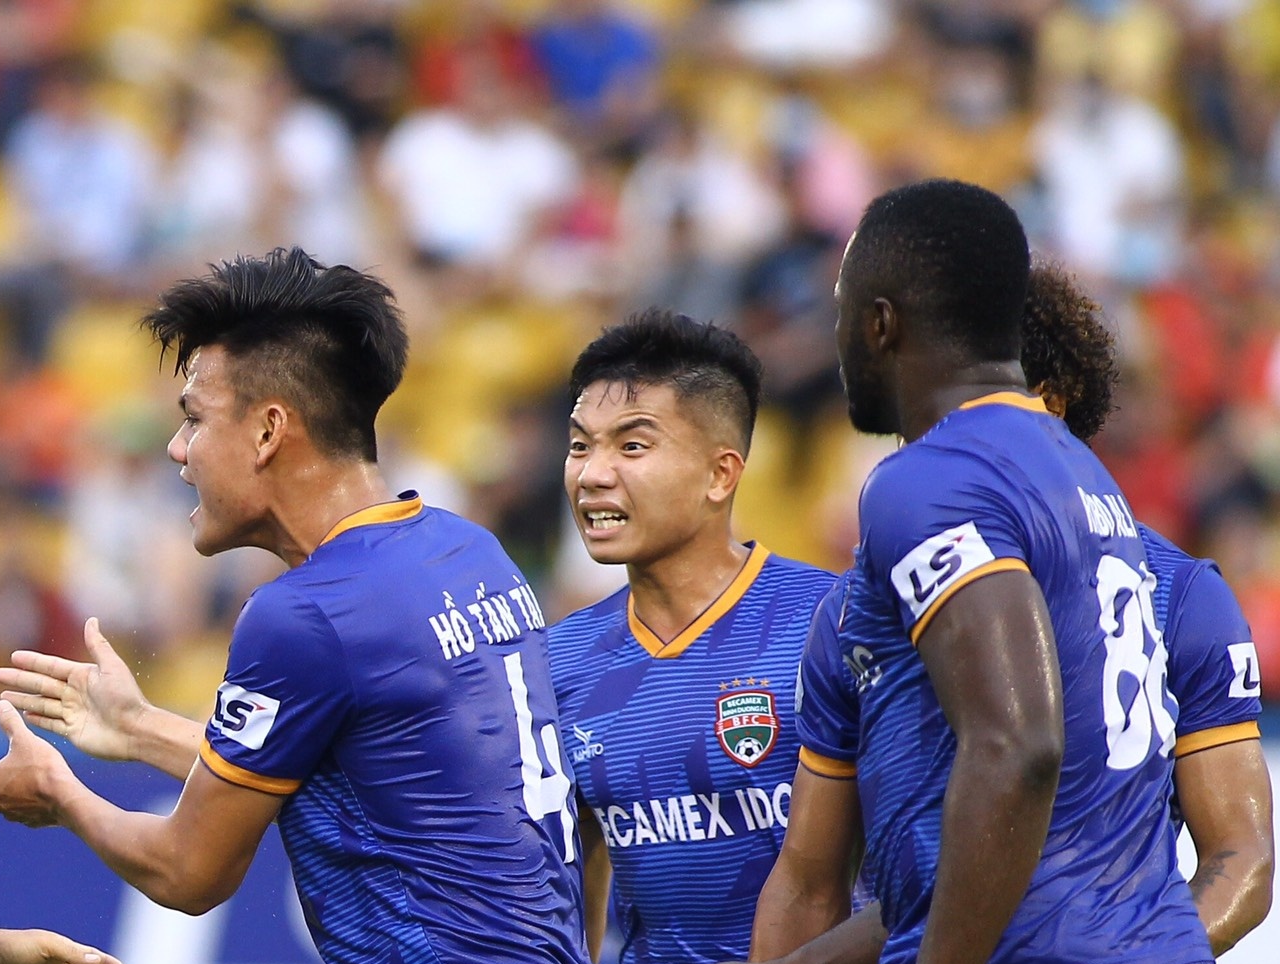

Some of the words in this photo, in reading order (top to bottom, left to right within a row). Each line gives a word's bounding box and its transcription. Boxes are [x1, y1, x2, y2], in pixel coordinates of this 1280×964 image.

[908, 543, 963, 604] LS
[428, 590, 476, 661] HỒ
[466, 581, 521, 646] TẤN
[214, 689, 255, 732] LS
[502, 650, 575, 864] 4
[594, 792, 735, 848] ECAMEX
